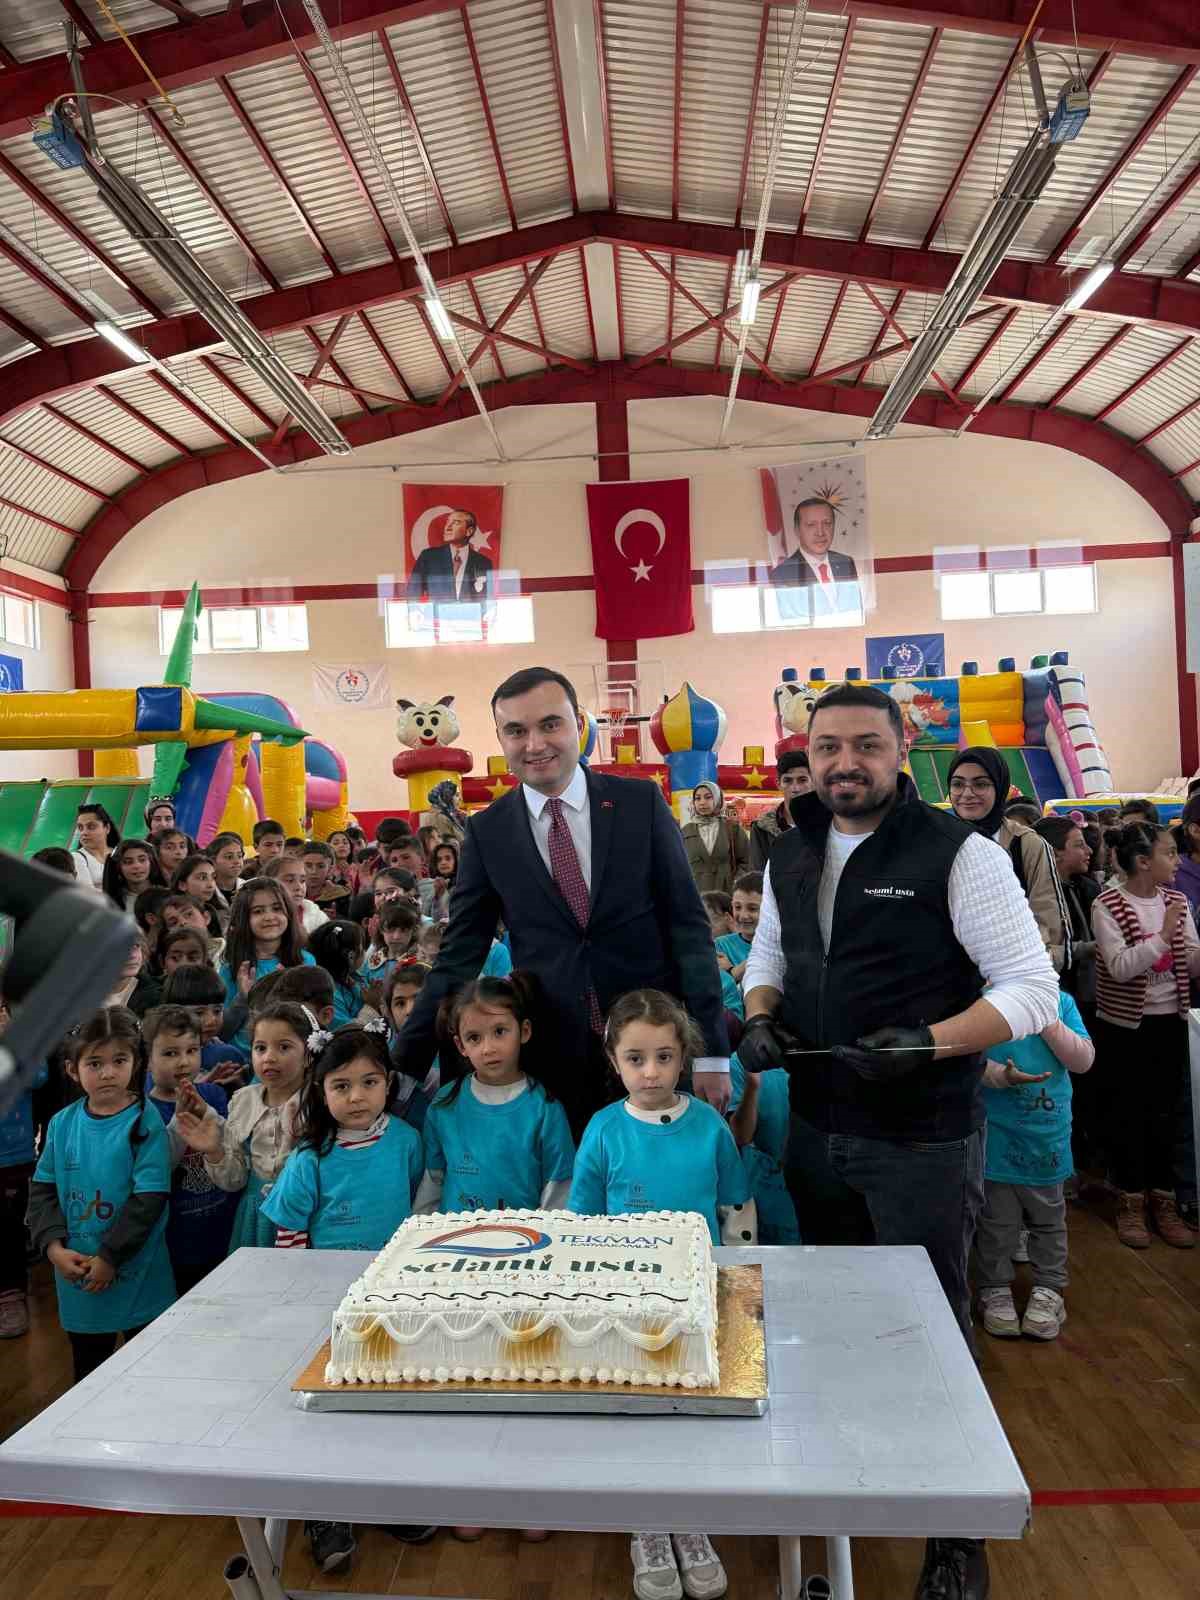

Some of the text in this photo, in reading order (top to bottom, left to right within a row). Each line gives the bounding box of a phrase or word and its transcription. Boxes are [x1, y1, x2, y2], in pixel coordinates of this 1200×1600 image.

[559, 1234, 674, 1246] TEKMAN
[402, 1254, 662, 1274] selami usta
